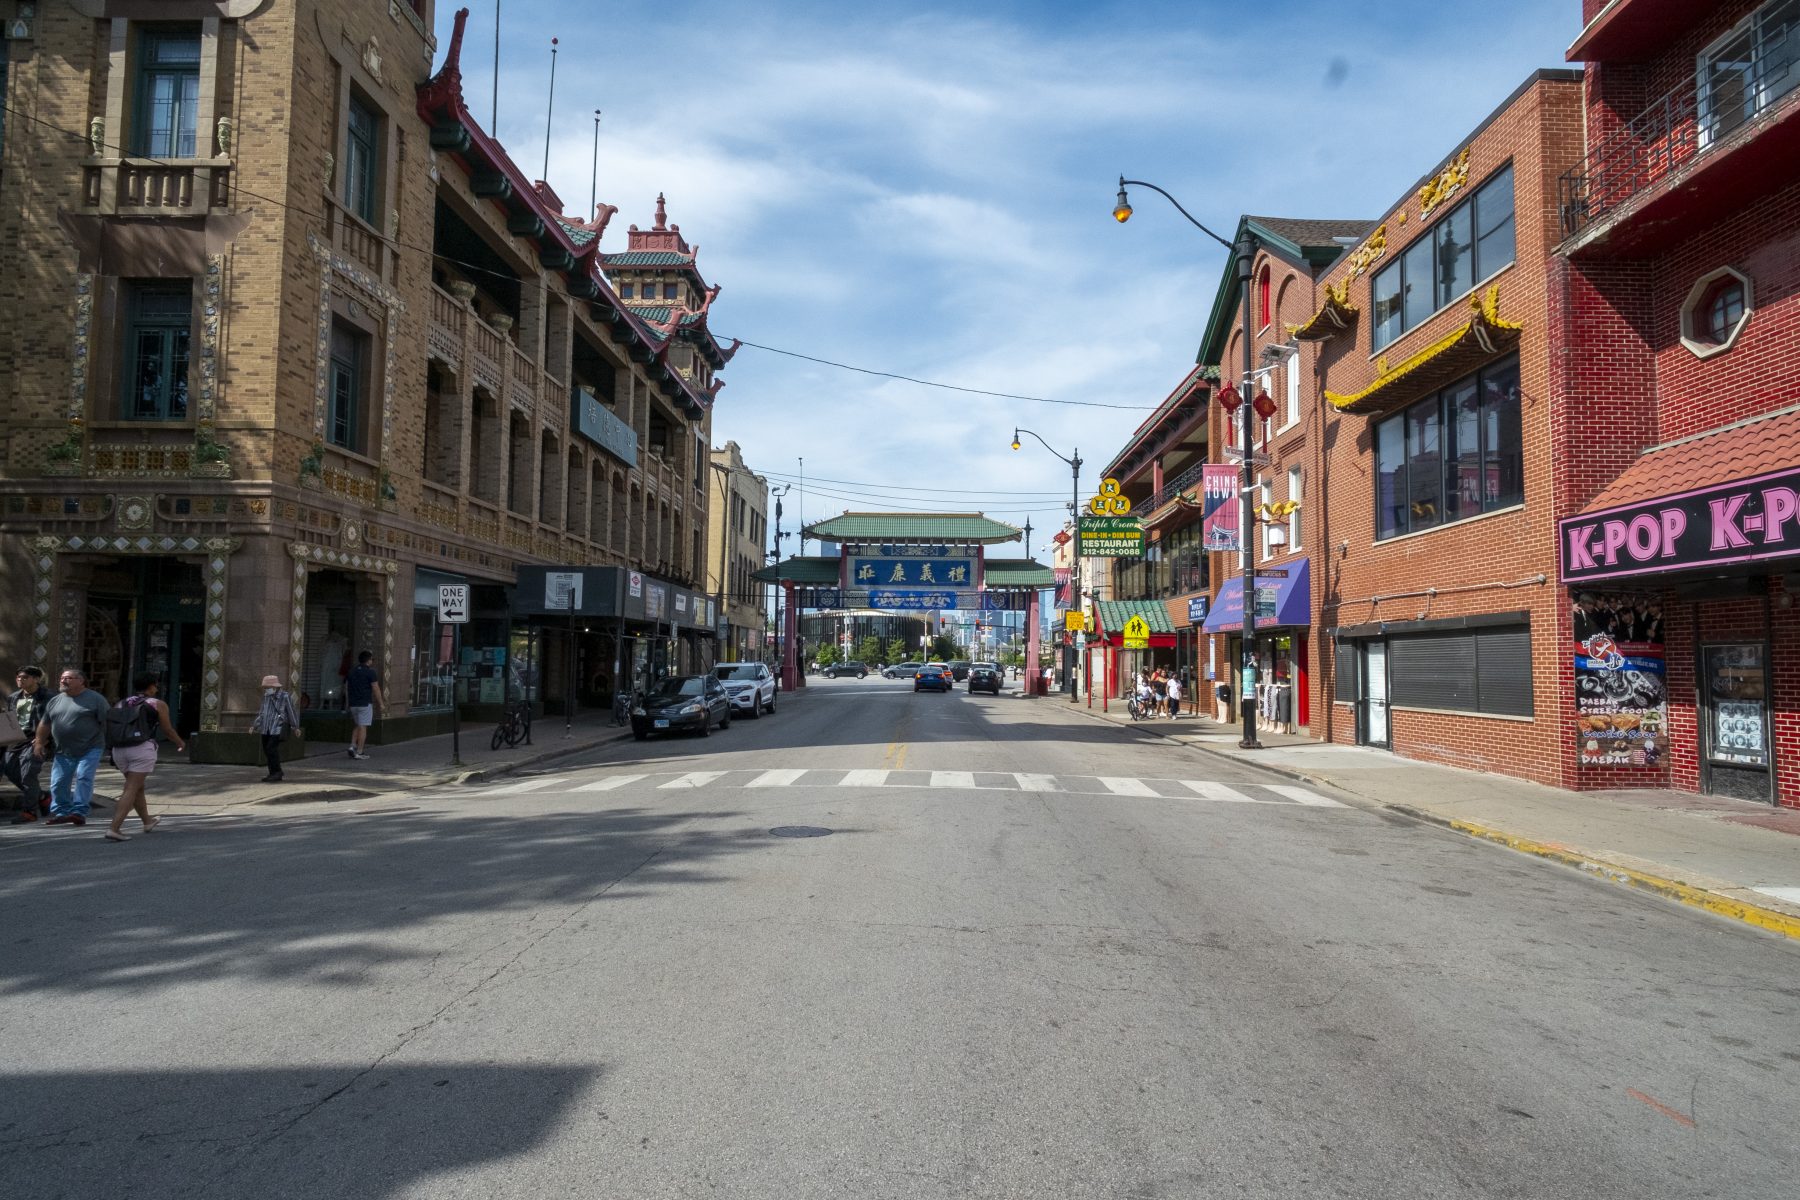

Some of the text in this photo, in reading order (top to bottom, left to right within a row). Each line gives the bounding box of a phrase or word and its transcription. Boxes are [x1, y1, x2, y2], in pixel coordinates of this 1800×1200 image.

[1206, 475, 1237, 487] CHINA
[1206, 487, 1237, 499] TOWN
[1081, 518, 1108, 531] Triple
[1568, 487, 1800, 571] K-POP K-P
[442, 588, 464, 597] ONE
[442, 598, 464, 607] WAY
[1580, 697, 1618, 705] DAEBAK
[1580, 706, 1648, 714] STREET FOOD
[1581, 755, 1629, 764] DAEBAK
